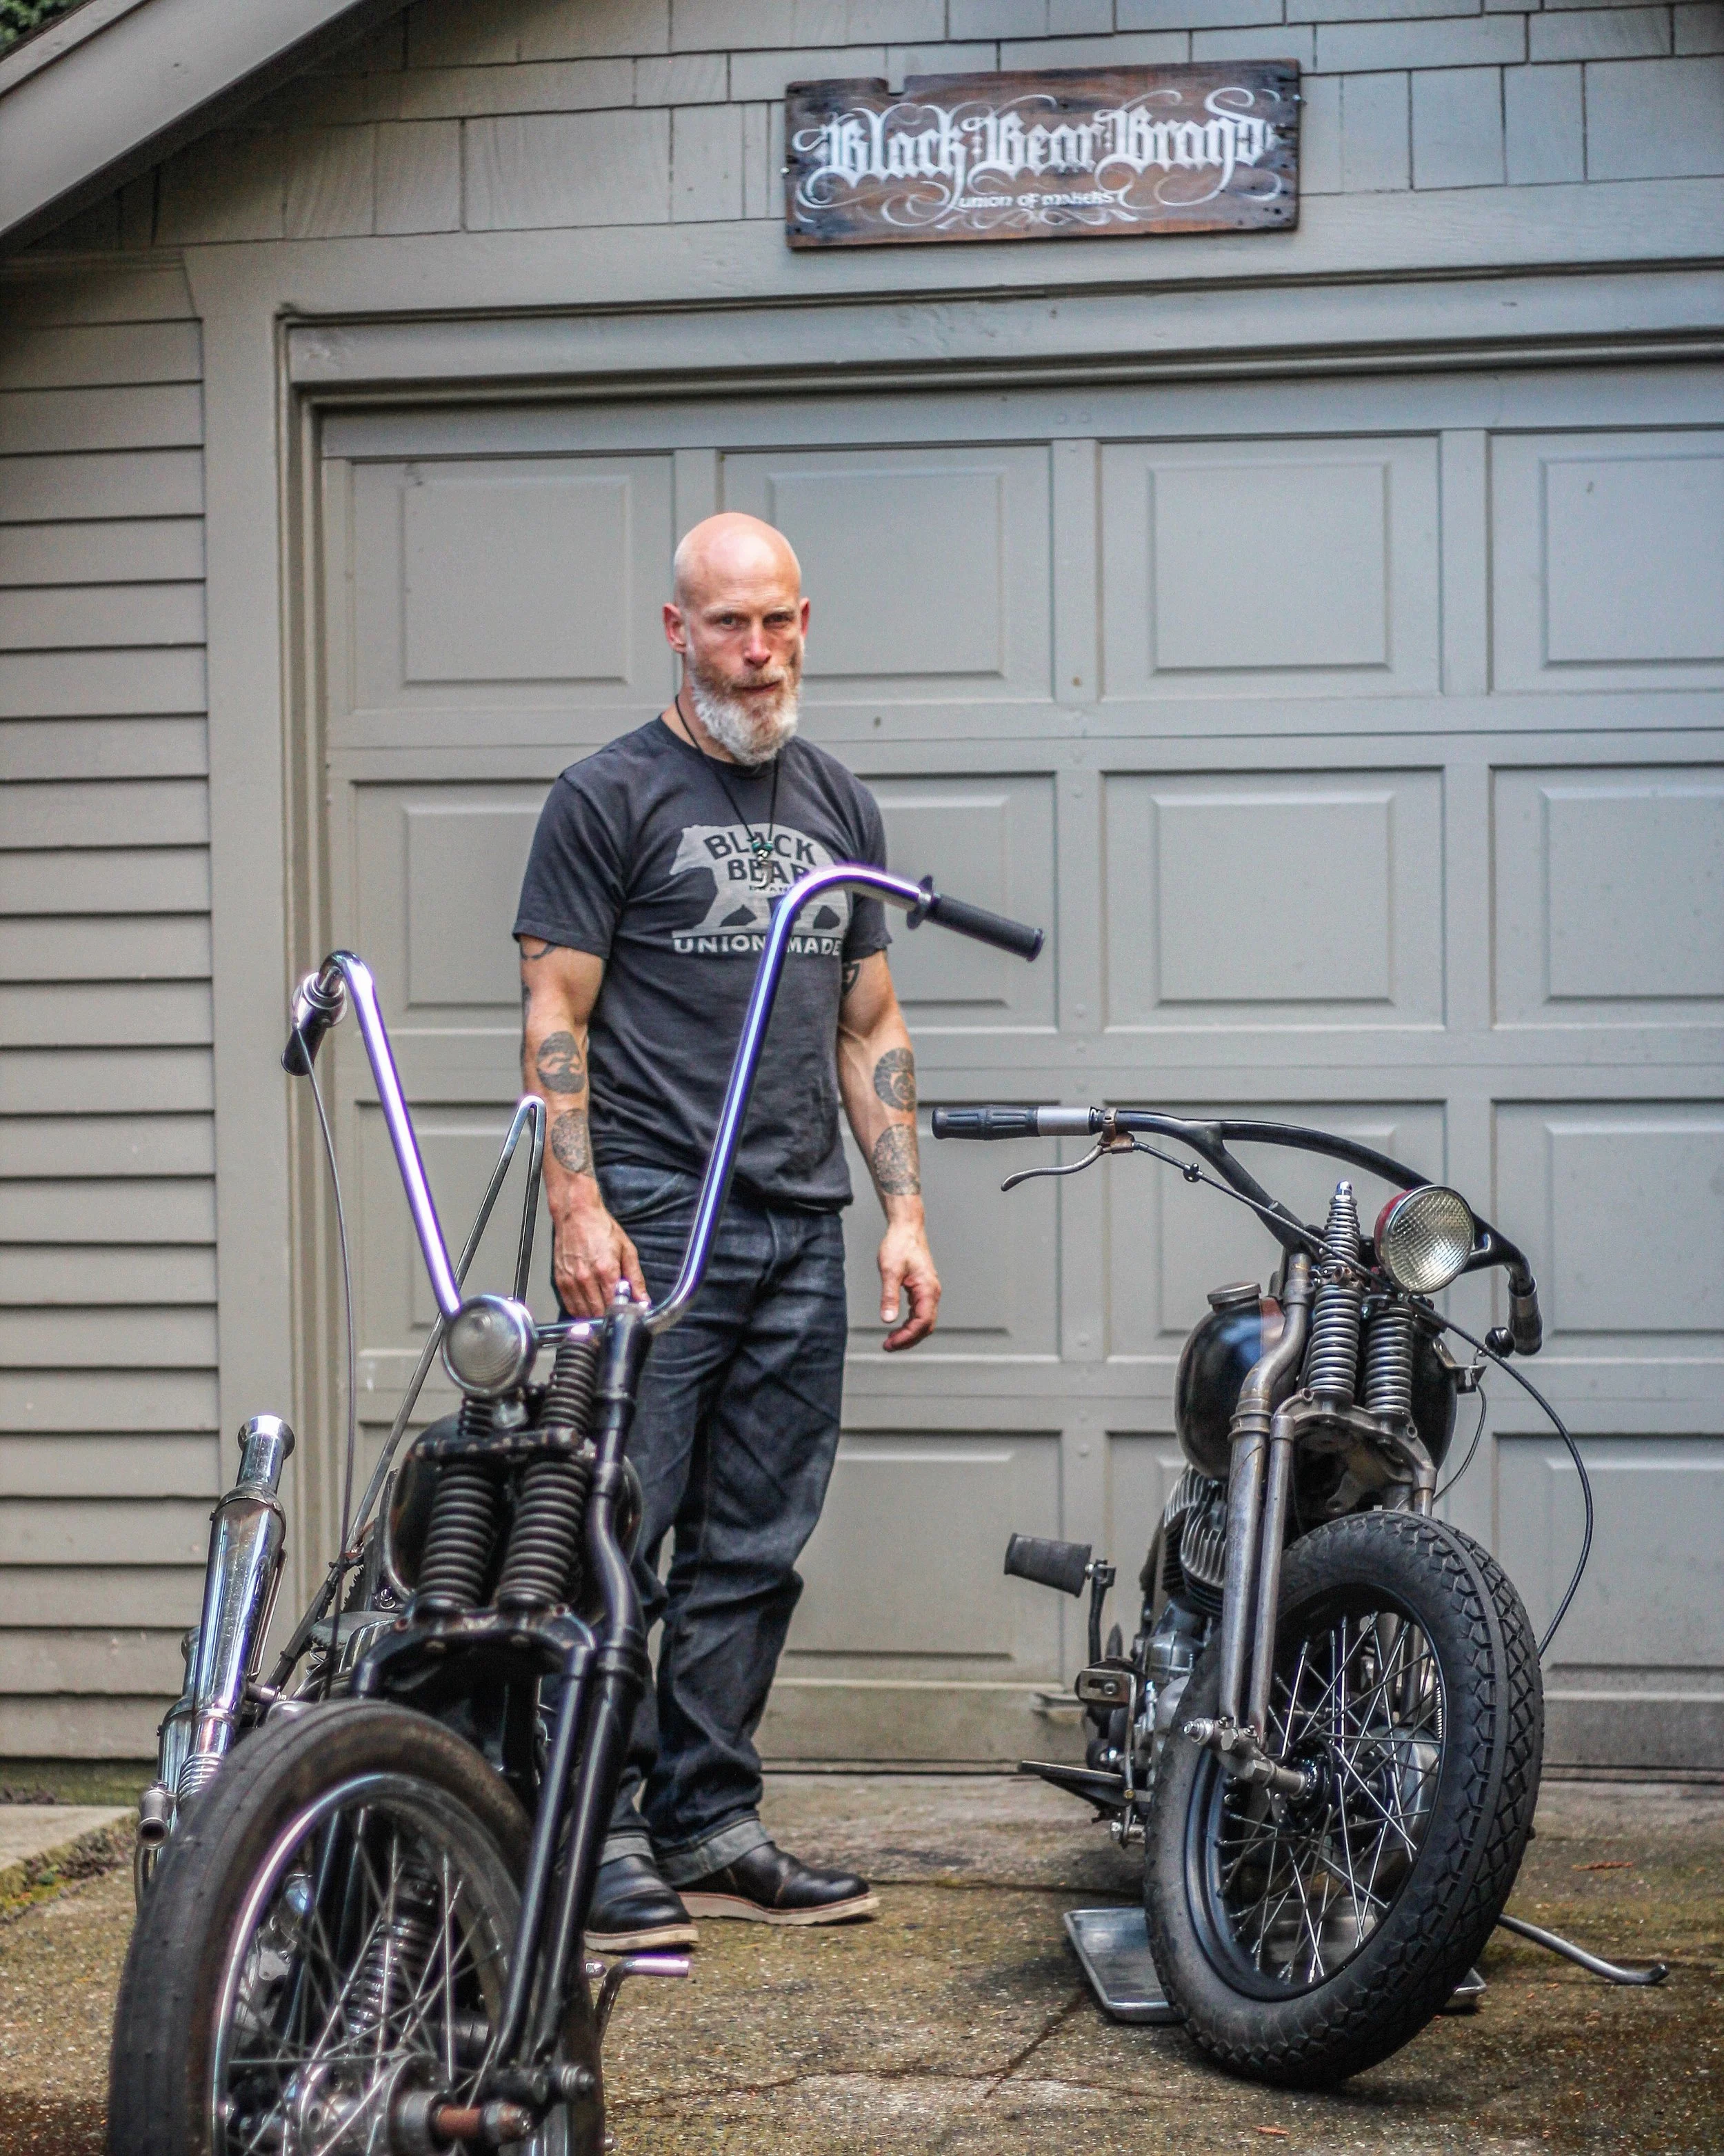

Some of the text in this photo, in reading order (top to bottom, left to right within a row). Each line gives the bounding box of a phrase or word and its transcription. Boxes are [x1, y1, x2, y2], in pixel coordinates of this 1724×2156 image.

[799, 92, 1281, 204] Black Bear Brand
[674, 935, 841, 957] UNION MADE
